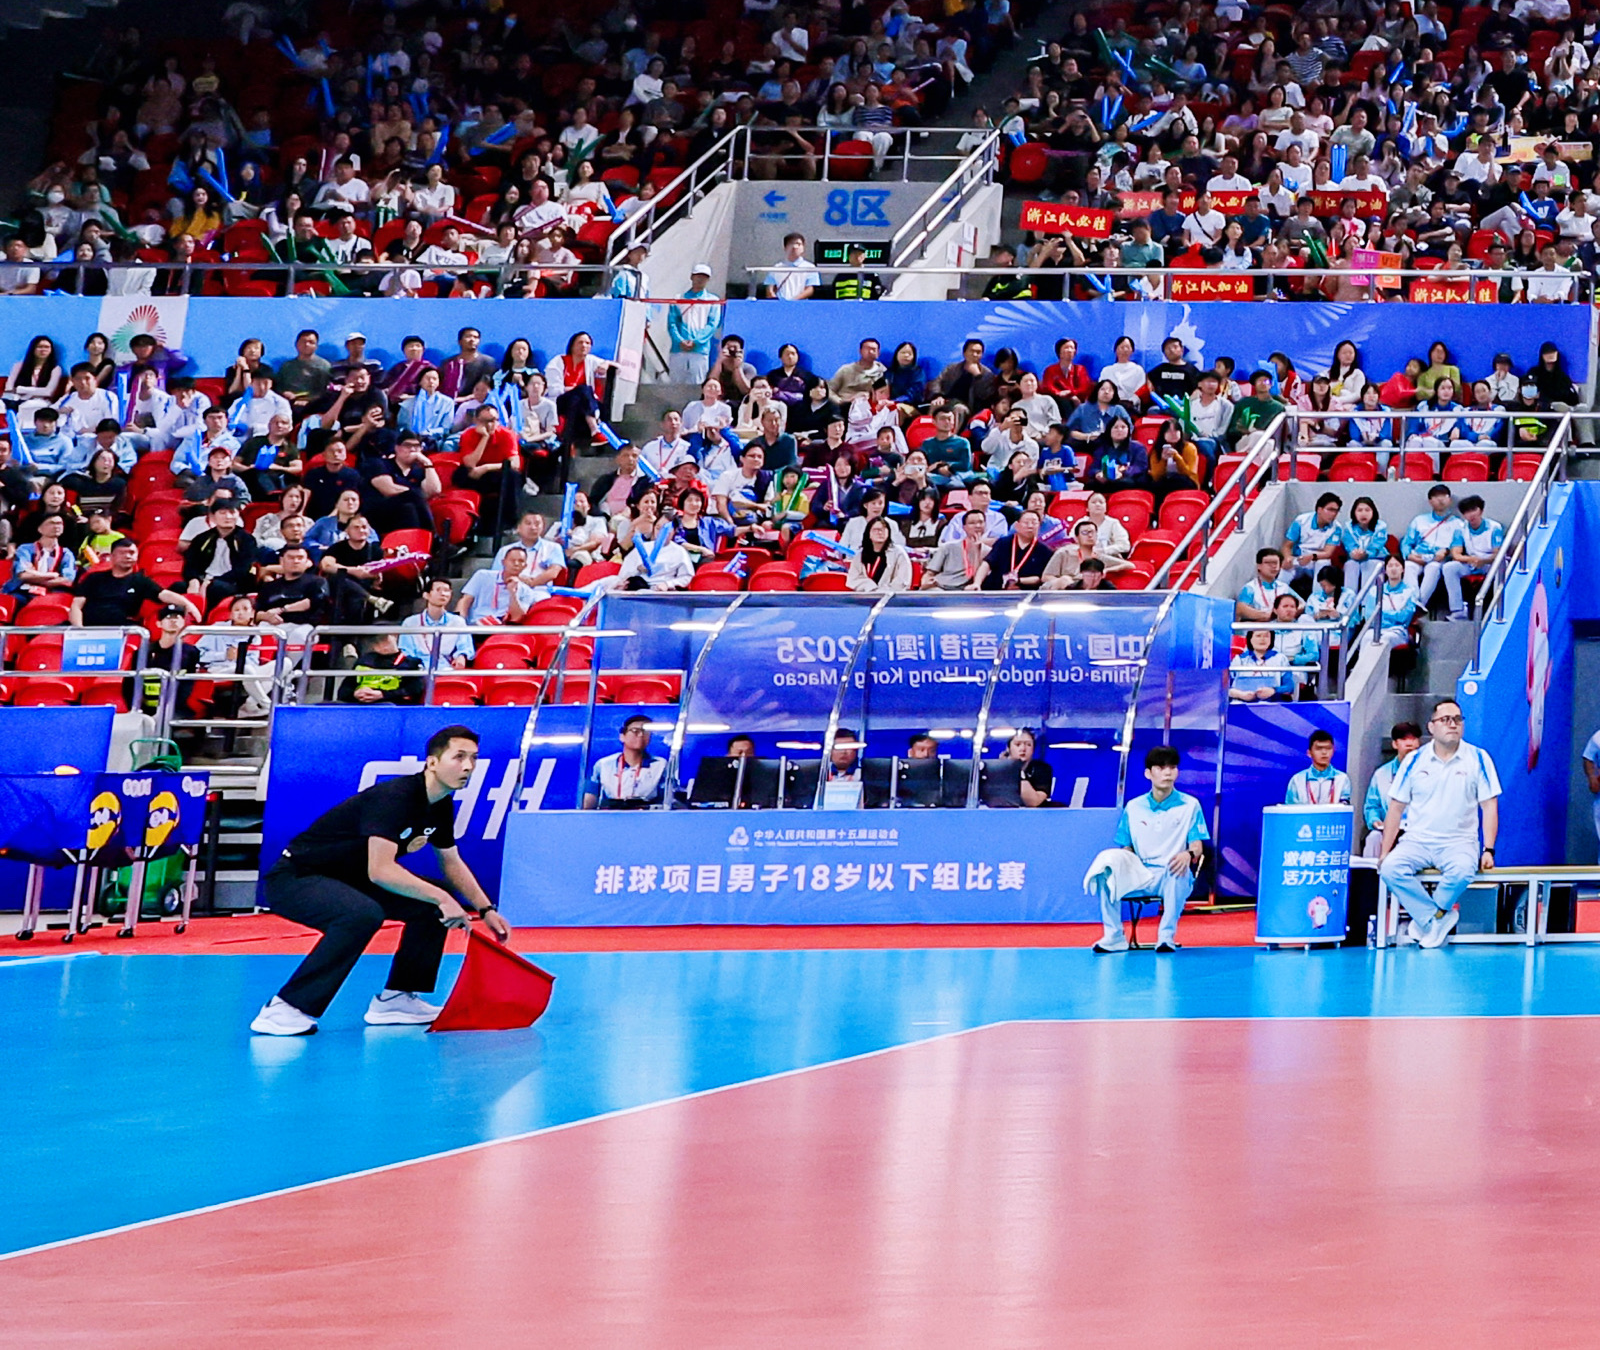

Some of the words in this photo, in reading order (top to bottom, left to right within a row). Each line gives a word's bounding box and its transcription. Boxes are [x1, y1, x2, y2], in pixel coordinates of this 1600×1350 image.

[824, 189, 891, 226] 8区
[1026, 206, 1106, 231] 浙江队必胜
[594, 860, 1027, 894] 排球项目男子18岁以下组比赛
